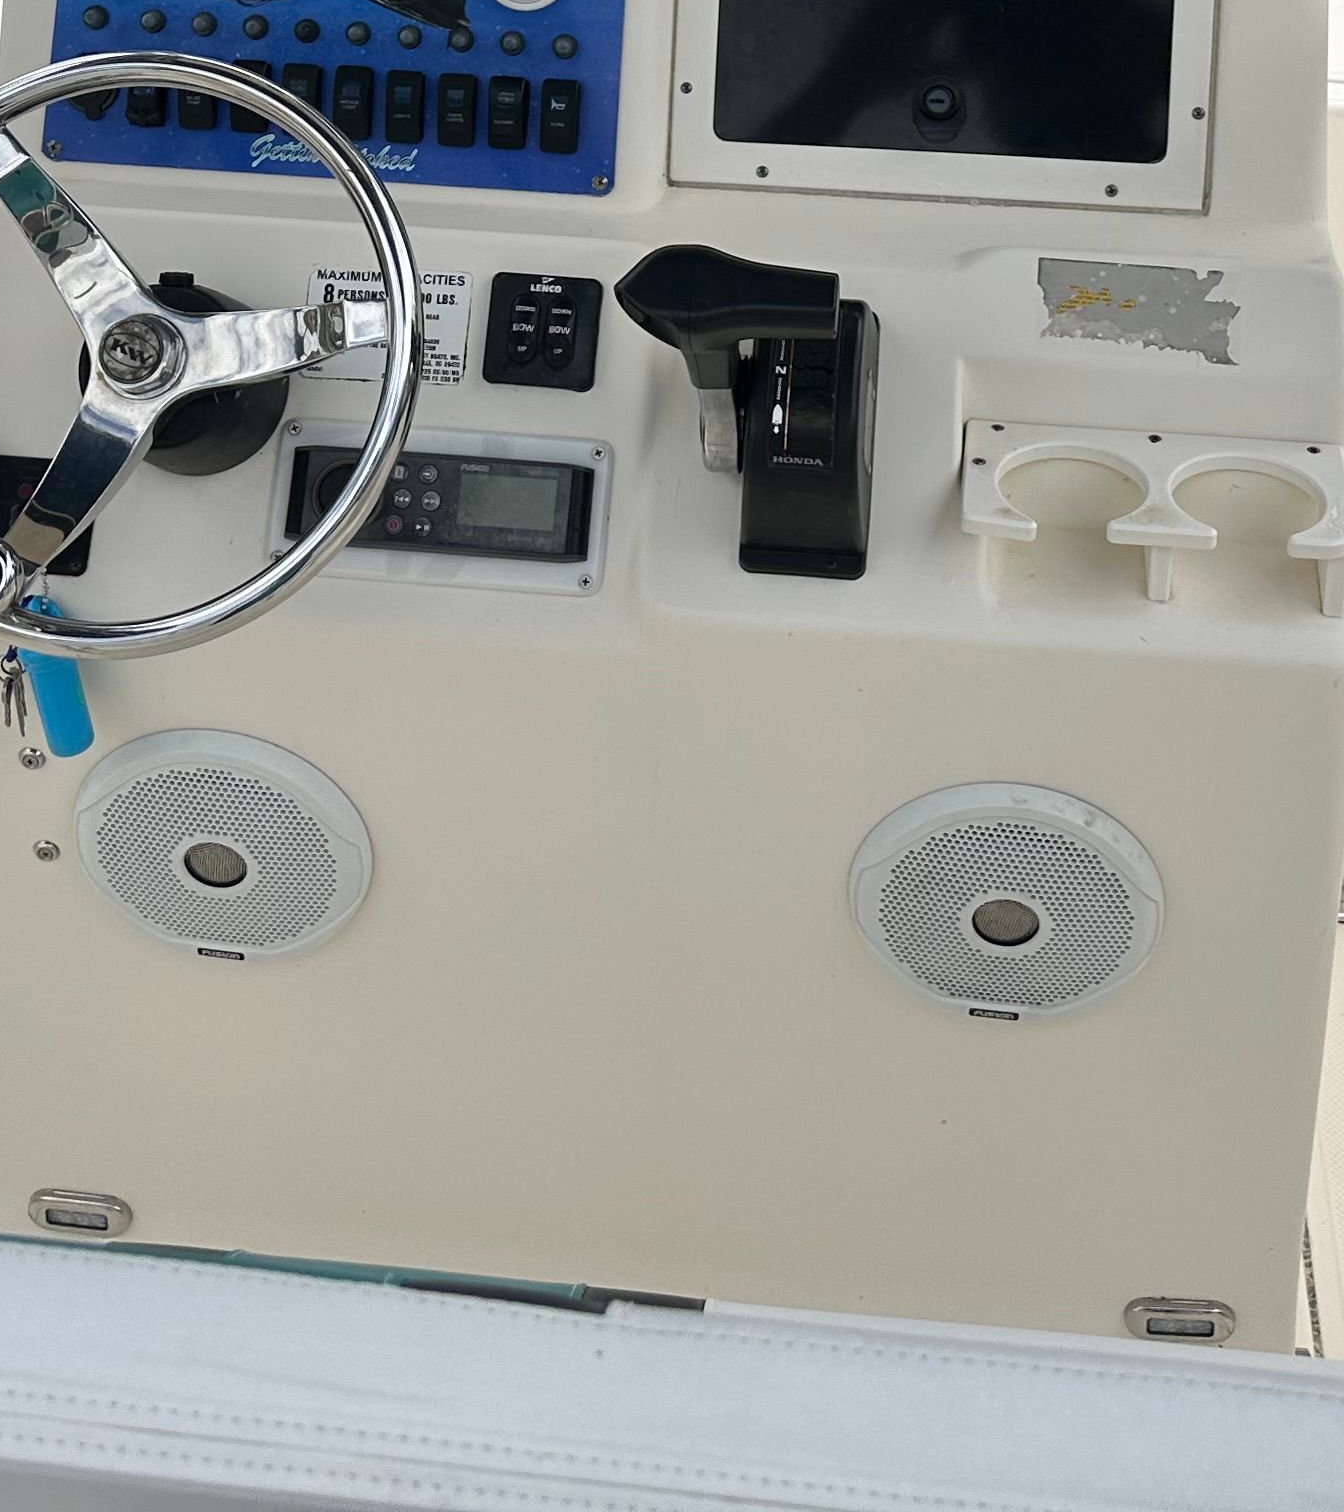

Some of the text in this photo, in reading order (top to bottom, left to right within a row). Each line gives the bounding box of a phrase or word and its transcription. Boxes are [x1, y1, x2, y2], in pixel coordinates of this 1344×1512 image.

[360, 145, 419, 171] oked
[316, 270, 466, 287] MAXIMUM CITIES
[529, 283, 563, 294] LENCO
[323, 284, 335, 304] 8
[337, 289, 387, 301] PERSONS
[436, 294, 459, 306] LBS.
[512, 323, 536, 333] BOW
[548, 325, 571, 335] BOW
[772, 455, 825, 467] HONDA
[201, 949, 241, 959] FUSION
[973, 1009, 1015, 1020] FUSION
